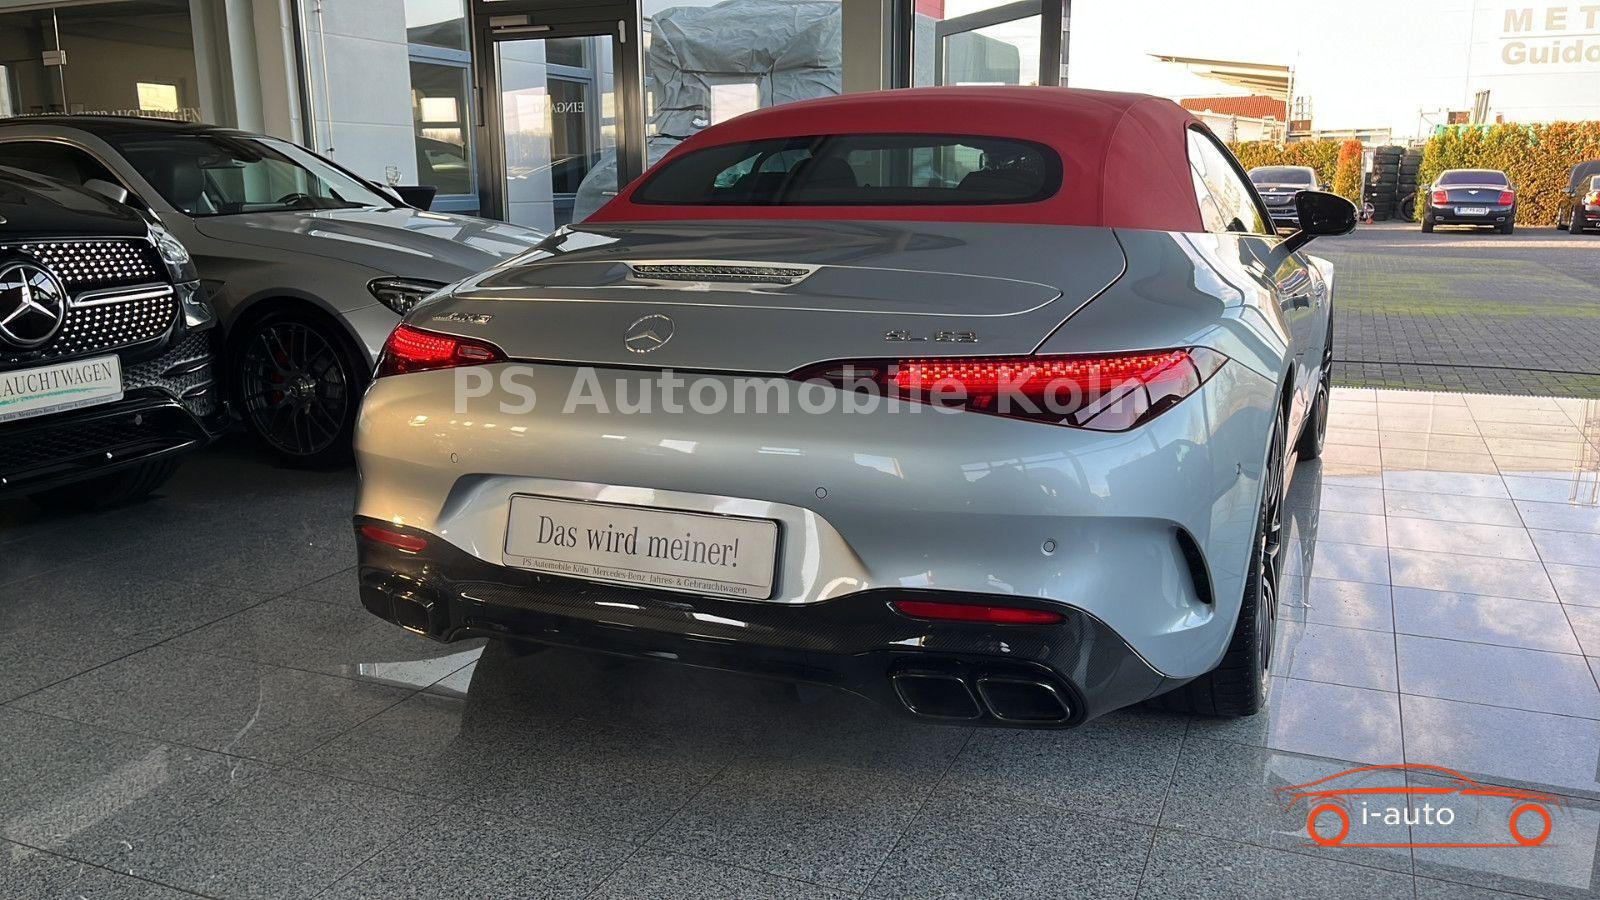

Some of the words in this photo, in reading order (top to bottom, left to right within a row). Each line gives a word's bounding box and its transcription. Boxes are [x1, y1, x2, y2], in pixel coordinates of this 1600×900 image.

[1502, 39, 1600, 65] Guido
[883, 330, 928, 341] SL
[935, 330, 979, 342] 63
[0, 361, 113, 398] AUCHTWAGEN
[536, 515, 577, 548] Das
[587, 524, 638, 555] wird
[647, 533, 739, 568] meiner!
[522, 557, 532, 566] PS
[534, 560, 572, 570] Automobile
[573, 564, 589, 574] Köln
[592, 566, 646, 581] Mercedes-Benz
[649, 574, 675, 585] Jahres-
[684, 579, 748, 595] Gebrauchtwagen
